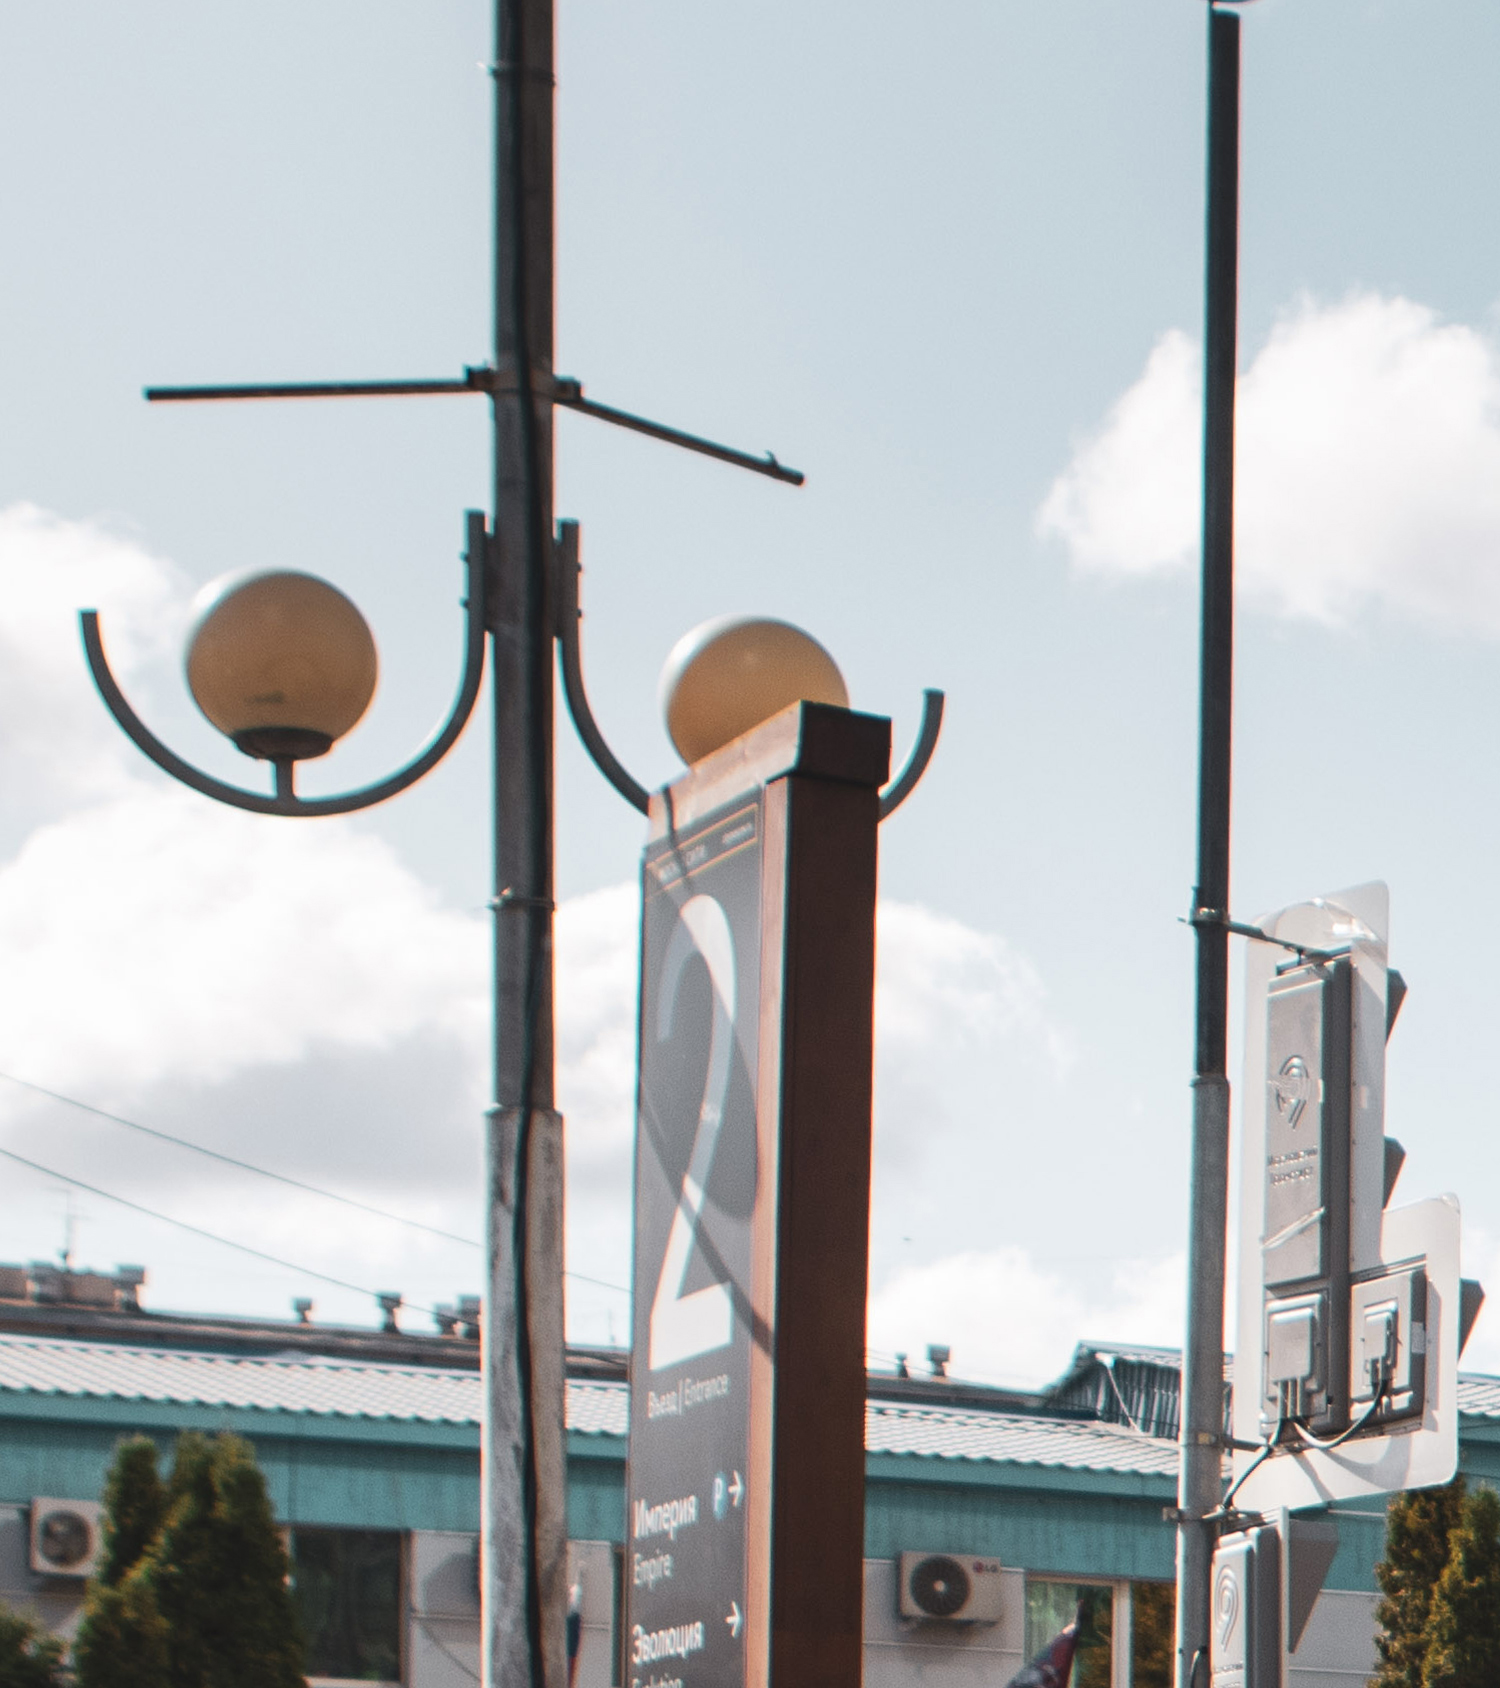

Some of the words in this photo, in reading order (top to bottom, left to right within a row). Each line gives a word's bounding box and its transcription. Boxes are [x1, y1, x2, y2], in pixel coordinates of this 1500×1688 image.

[650, 893, 737, 1372] 2
[685, 1374, 729, 1406] Entrance
[632, 1495, 697, 1541] Империя
[634, 1549, 673, 1589] Empire
[632, 1621, 704, 1665] Эволюция
